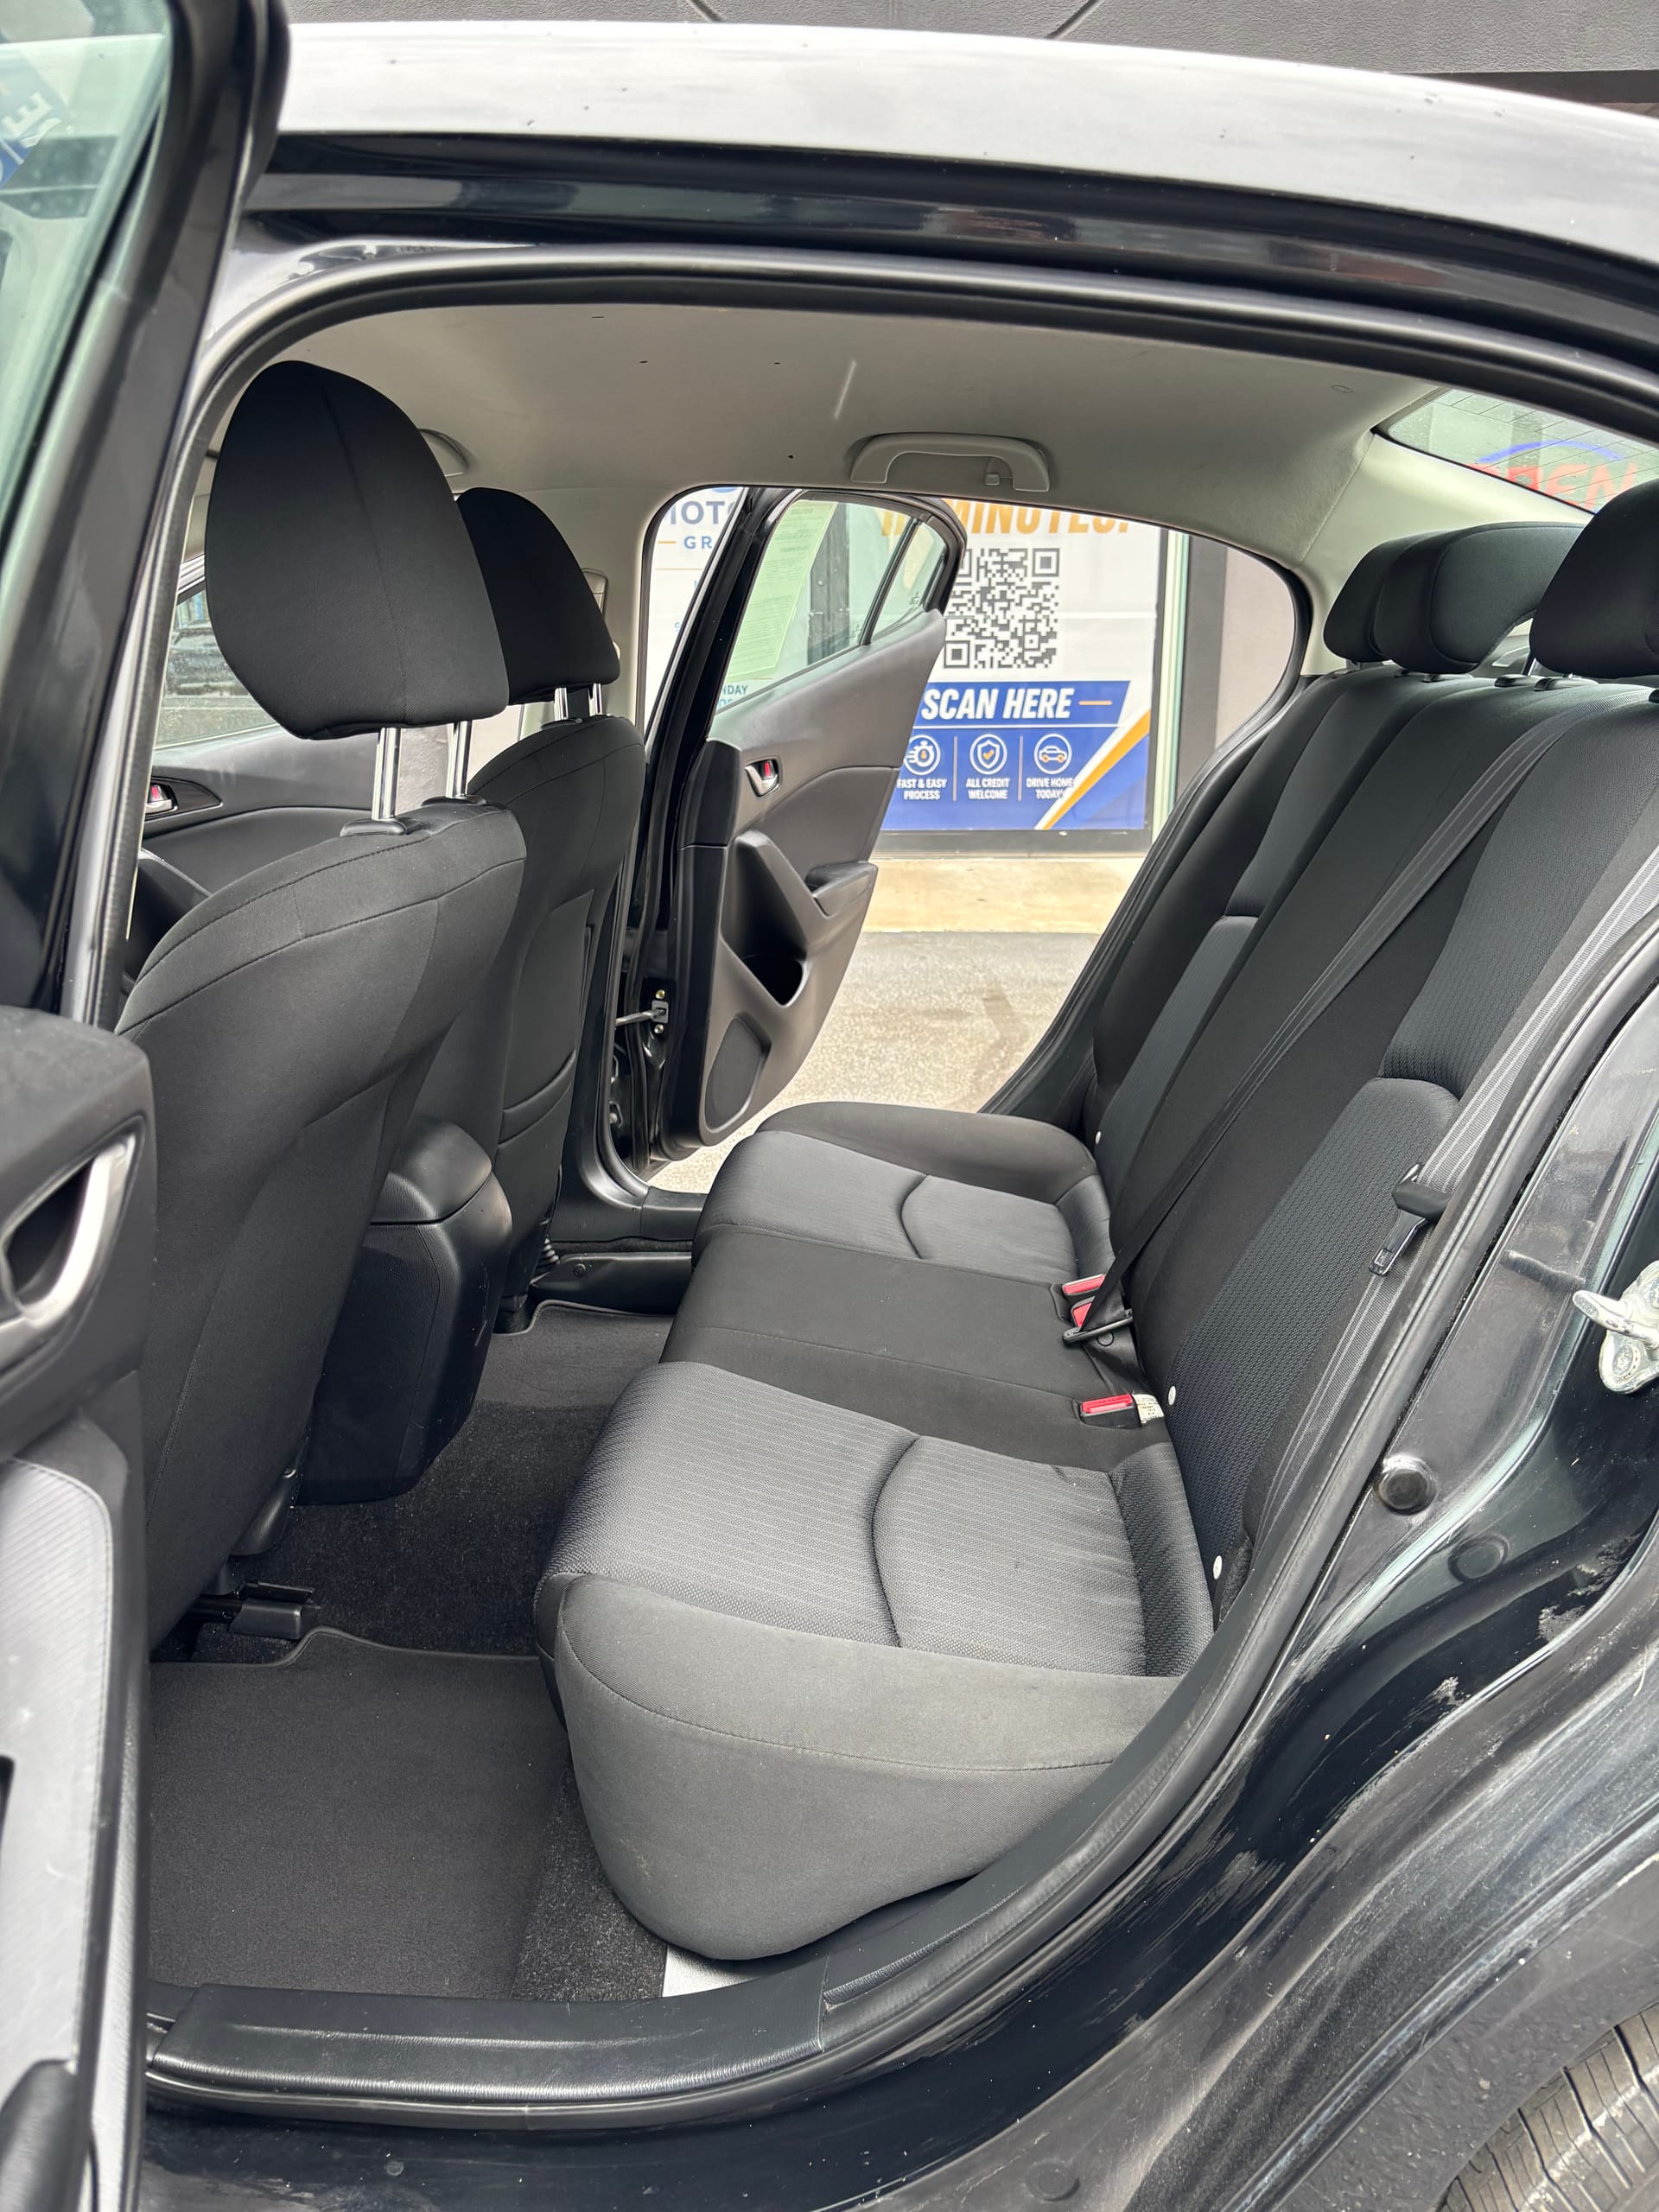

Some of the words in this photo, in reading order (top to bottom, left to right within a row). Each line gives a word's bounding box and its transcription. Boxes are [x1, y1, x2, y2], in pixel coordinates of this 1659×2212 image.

[921, 689, 999, 720] SCAN
[1002, 688, 1075, 719] HERE
[897, 779, 917, 788] FAST
[925, 779, 947, 788] EASY
[965, 778, 982, 788] ALL
[982, 778, 1010, 788] CREDIT
[1026, 778, 1050, 788] DRIVE
[1051, 778, 1074, 788] HOME
[903, 789, 940, 800] PROCESS
[968, 789, 1007, 799] WELCOME
